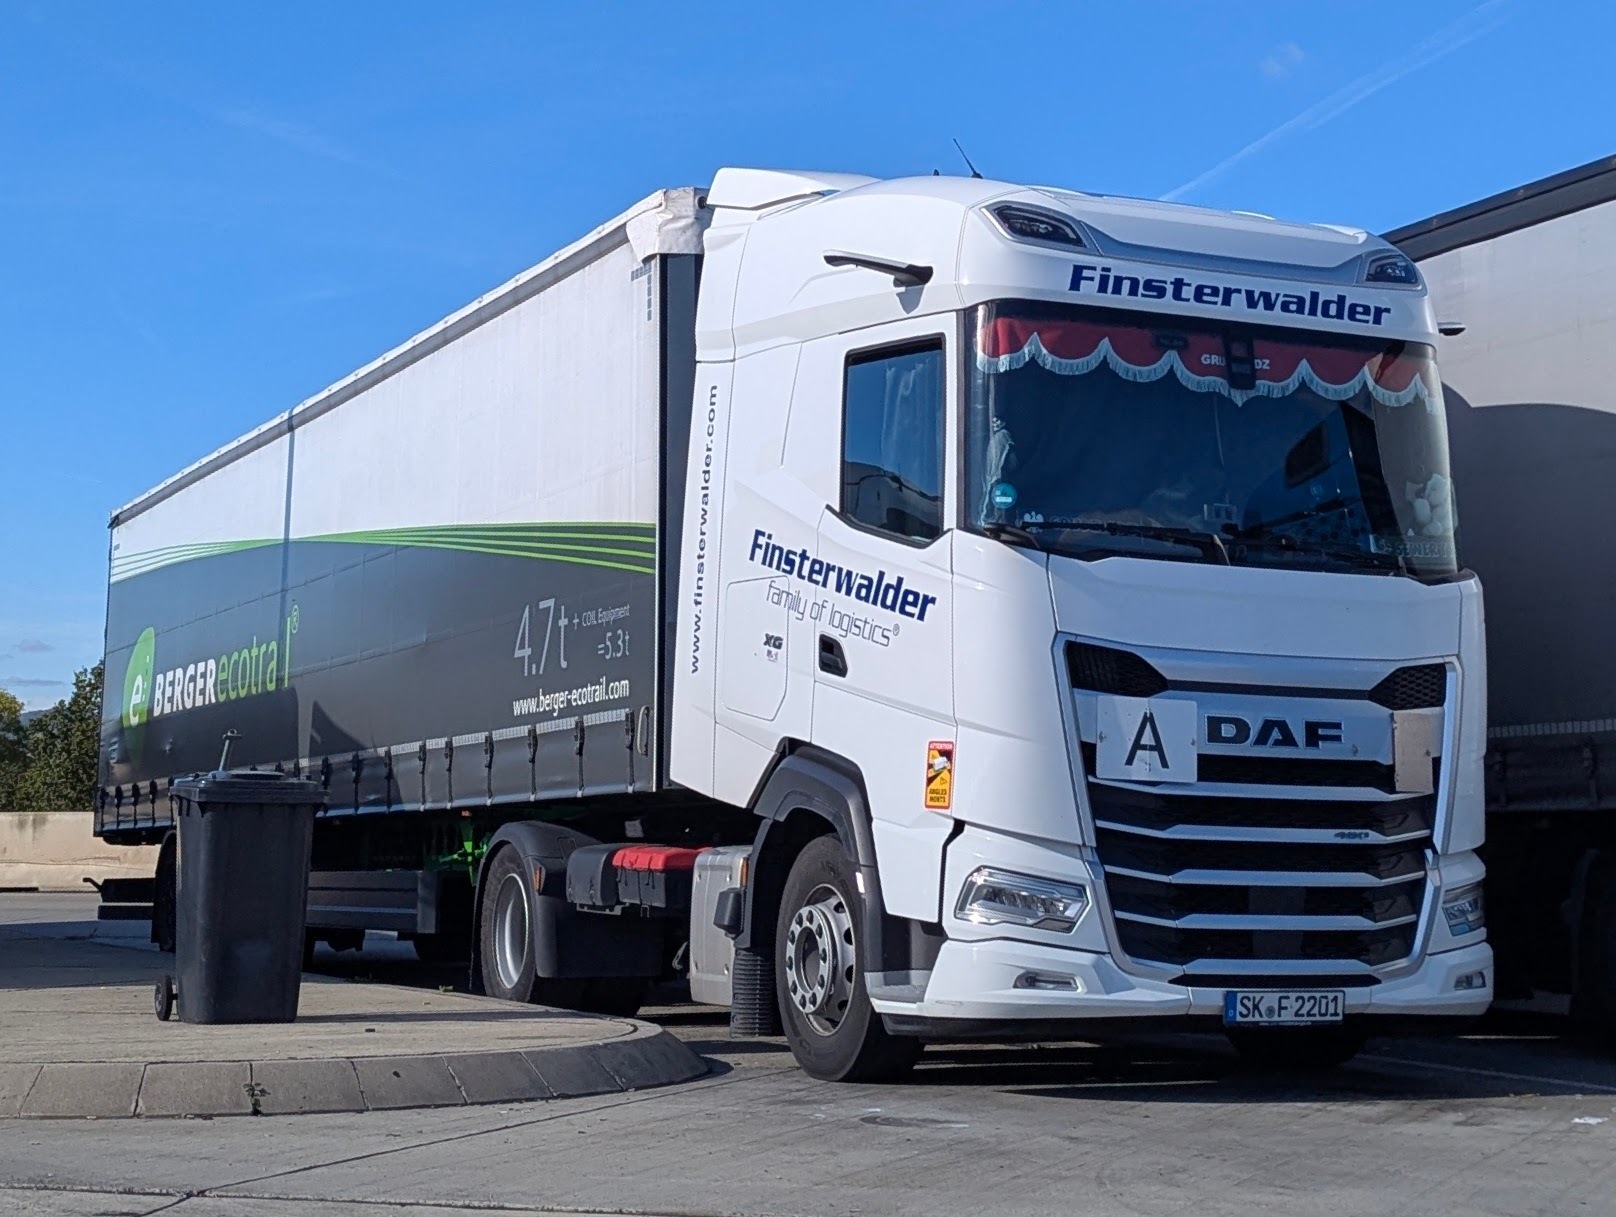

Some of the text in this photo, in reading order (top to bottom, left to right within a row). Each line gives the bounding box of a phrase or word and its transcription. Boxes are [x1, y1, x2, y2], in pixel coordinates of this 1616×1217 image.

[1068, 264, 1392, 327] Finsterwalder
[1200, 353, 1271, 370] GRUDZ
[691, 384, 718, 674] www.finsterwalder.com
[748, 528, 937, 623] Finsterwalder
[766, 579, 808, 621] family
[809, 599, 829, 622] of
[763, 632, 784, 650] XG
[512, 675, 630, 717] www.berger-ecotrail.com
[1124, 707, 1170, 770] A
[1205, 714, 1345, 749] DAF
[1238, 995, 1265, 1019] SK
[1277, 995, 1291, 1018] F
[1294, 995, 1341, 1018] 2201
